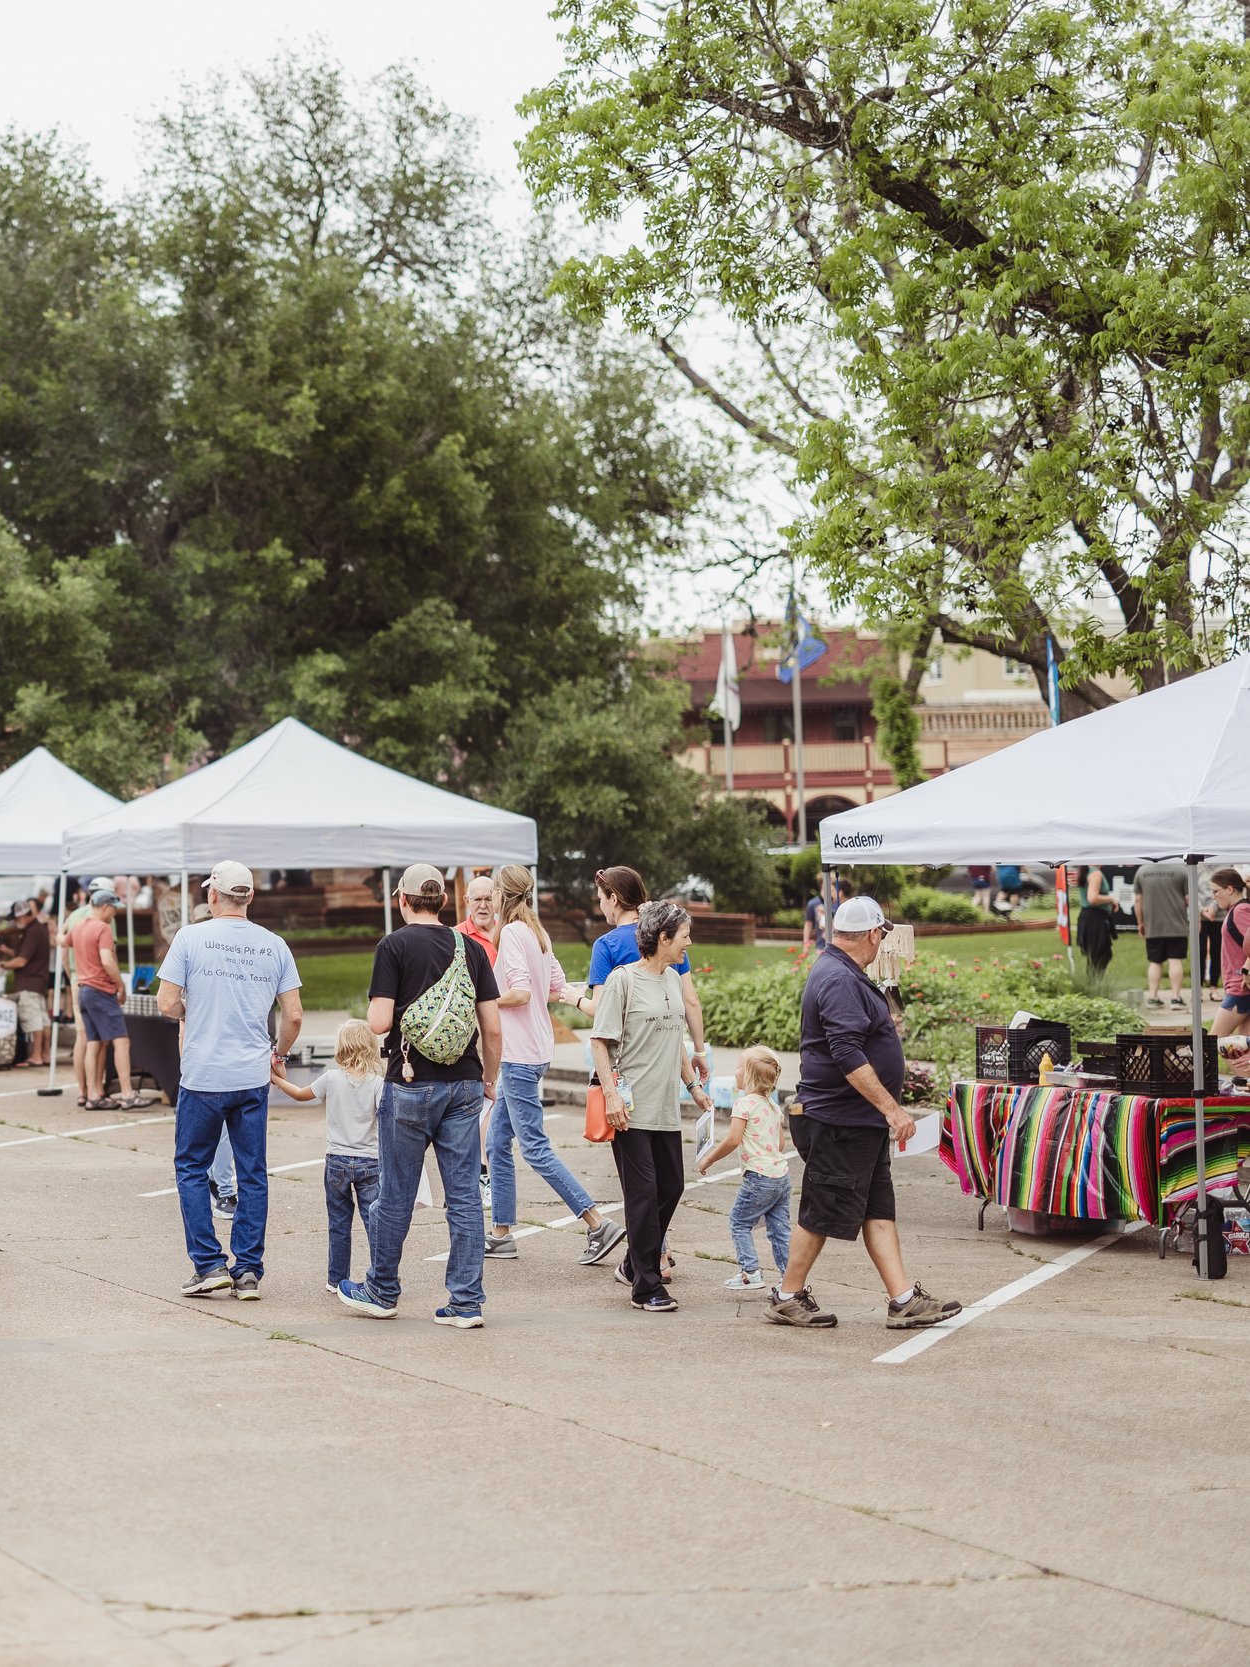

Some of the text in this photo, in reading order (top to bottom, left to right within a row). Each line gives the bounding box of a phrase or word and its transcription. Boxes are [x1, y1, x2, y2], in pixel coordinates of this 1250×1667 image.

[833, 831, 883, 850] Academy
[204, 940, 272, 956] Wessels Pit #2
[249, 973, 271, 982] Texas
